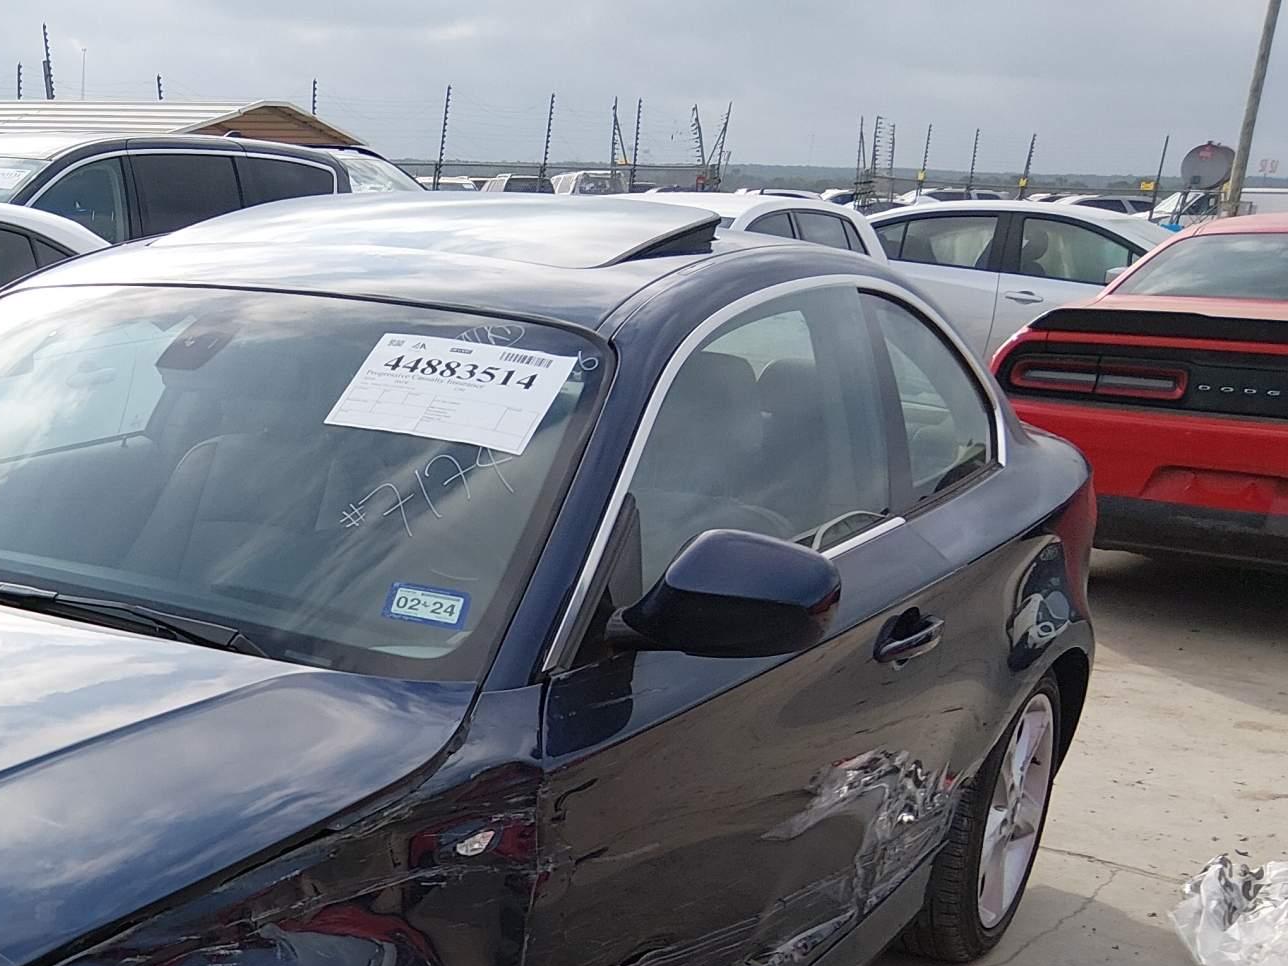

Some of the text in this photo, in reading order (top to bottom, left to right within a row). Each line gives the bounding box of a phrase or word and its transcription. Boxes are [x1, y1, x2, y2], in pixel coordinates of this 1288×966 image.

[366, 369, 411, 382] Progressive
[411, 374, 444, 386] Casualty
[447, 379, 486, 389] Insurance
[384, 354, 539, 390] 44883514
